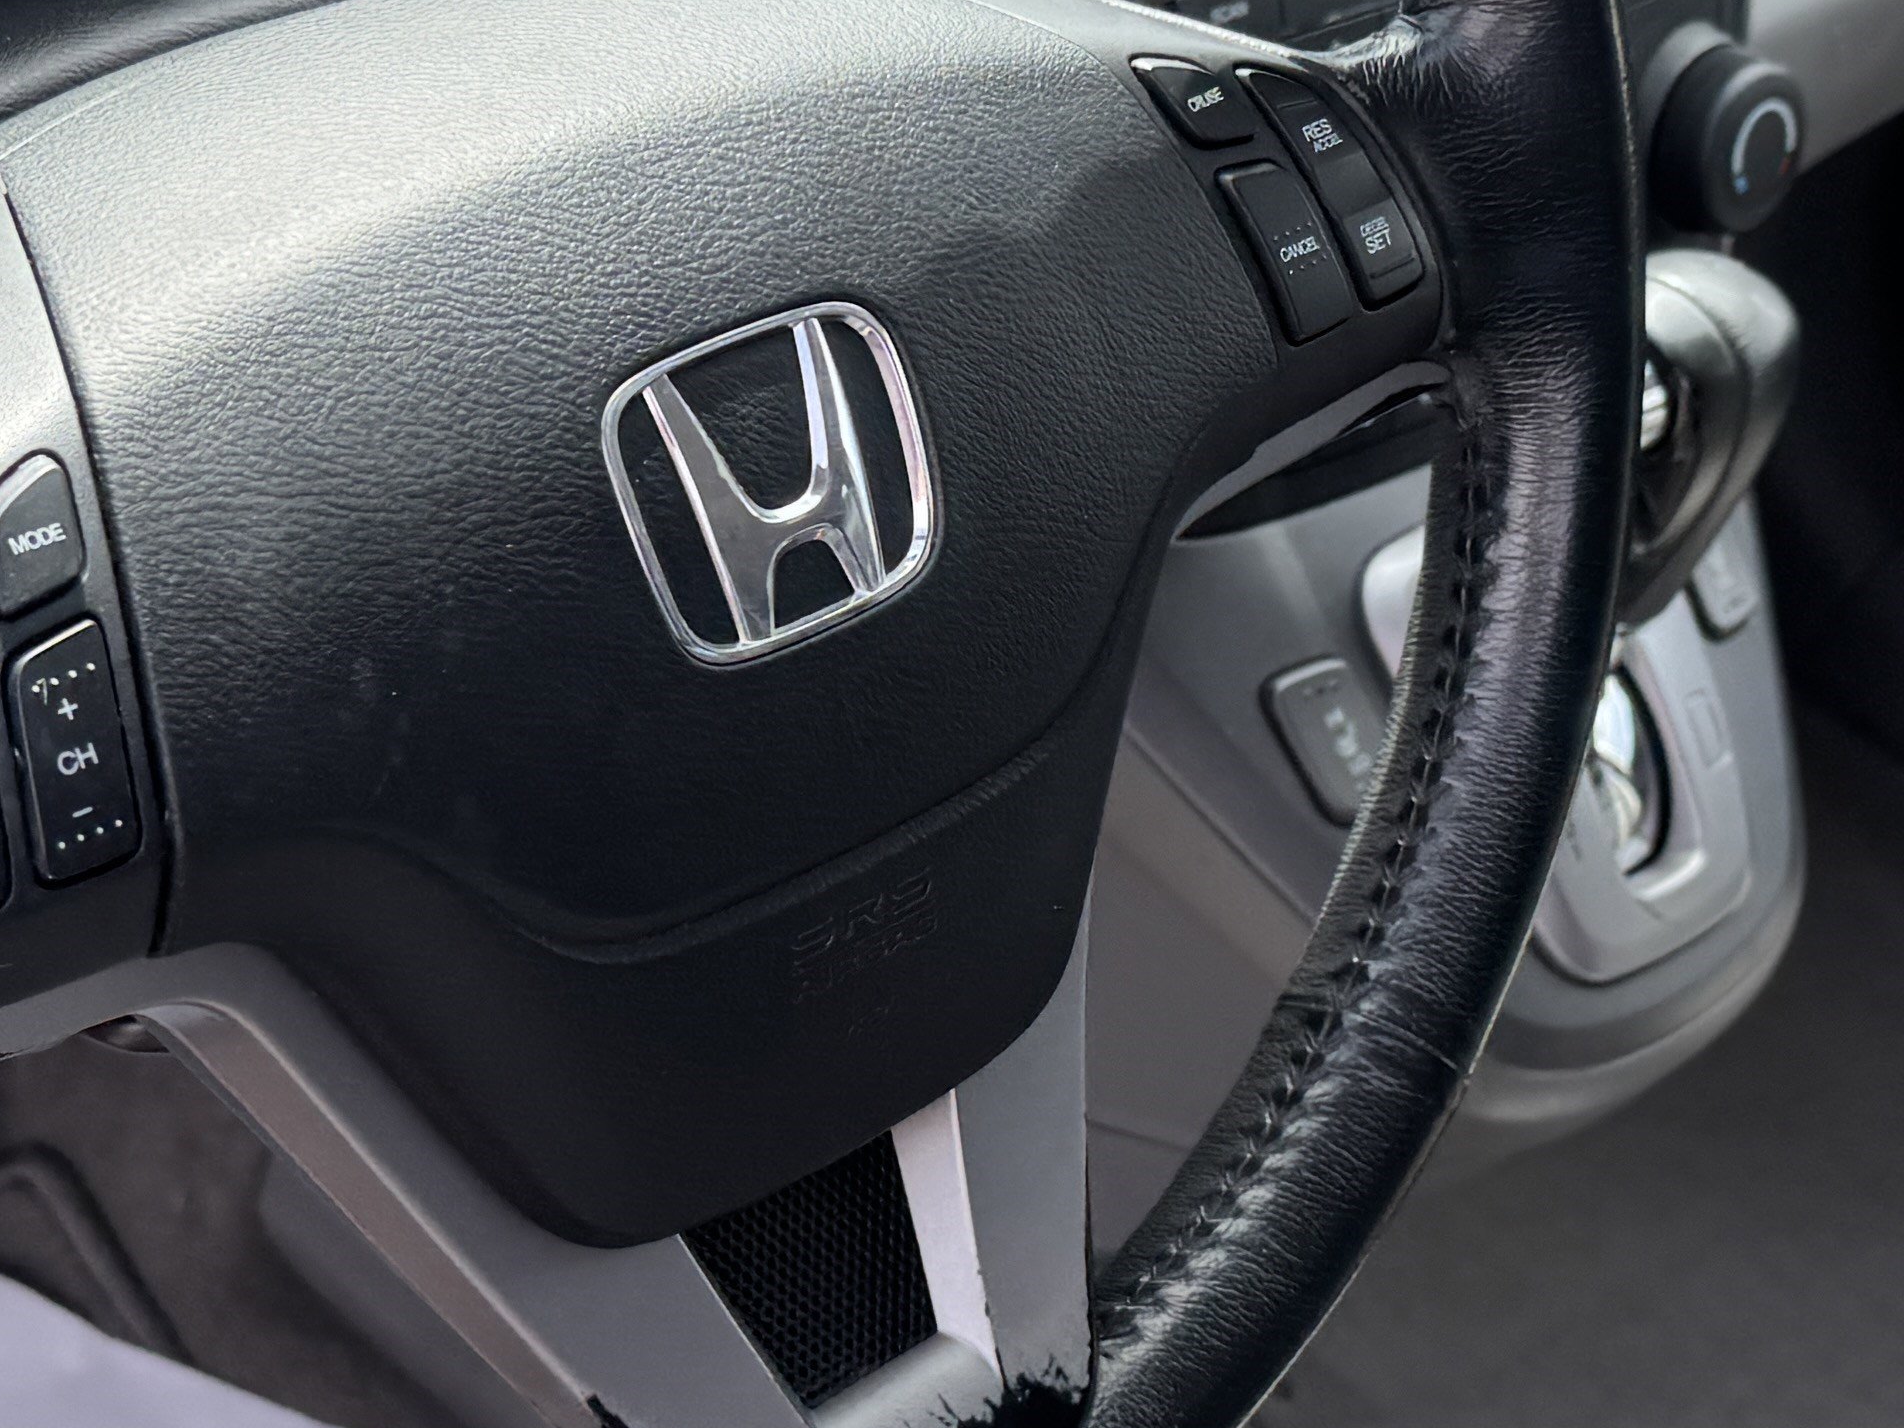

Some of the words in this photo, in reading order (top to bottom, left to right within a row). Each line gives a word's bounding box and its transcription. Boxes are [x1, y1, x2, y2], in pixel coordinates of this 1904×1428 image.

[1301, 118, 1333, 142] RES
[1312, 132, 1344, 153] ACCEL
[1359, 216, 1390, 236] DECEL
[1279, 235, 1321, 263] CANCEL
[1364, 228, 1392, 254] SET
[7, 522, 68, 557] MODE
[56, 741, 99, 776] CH
